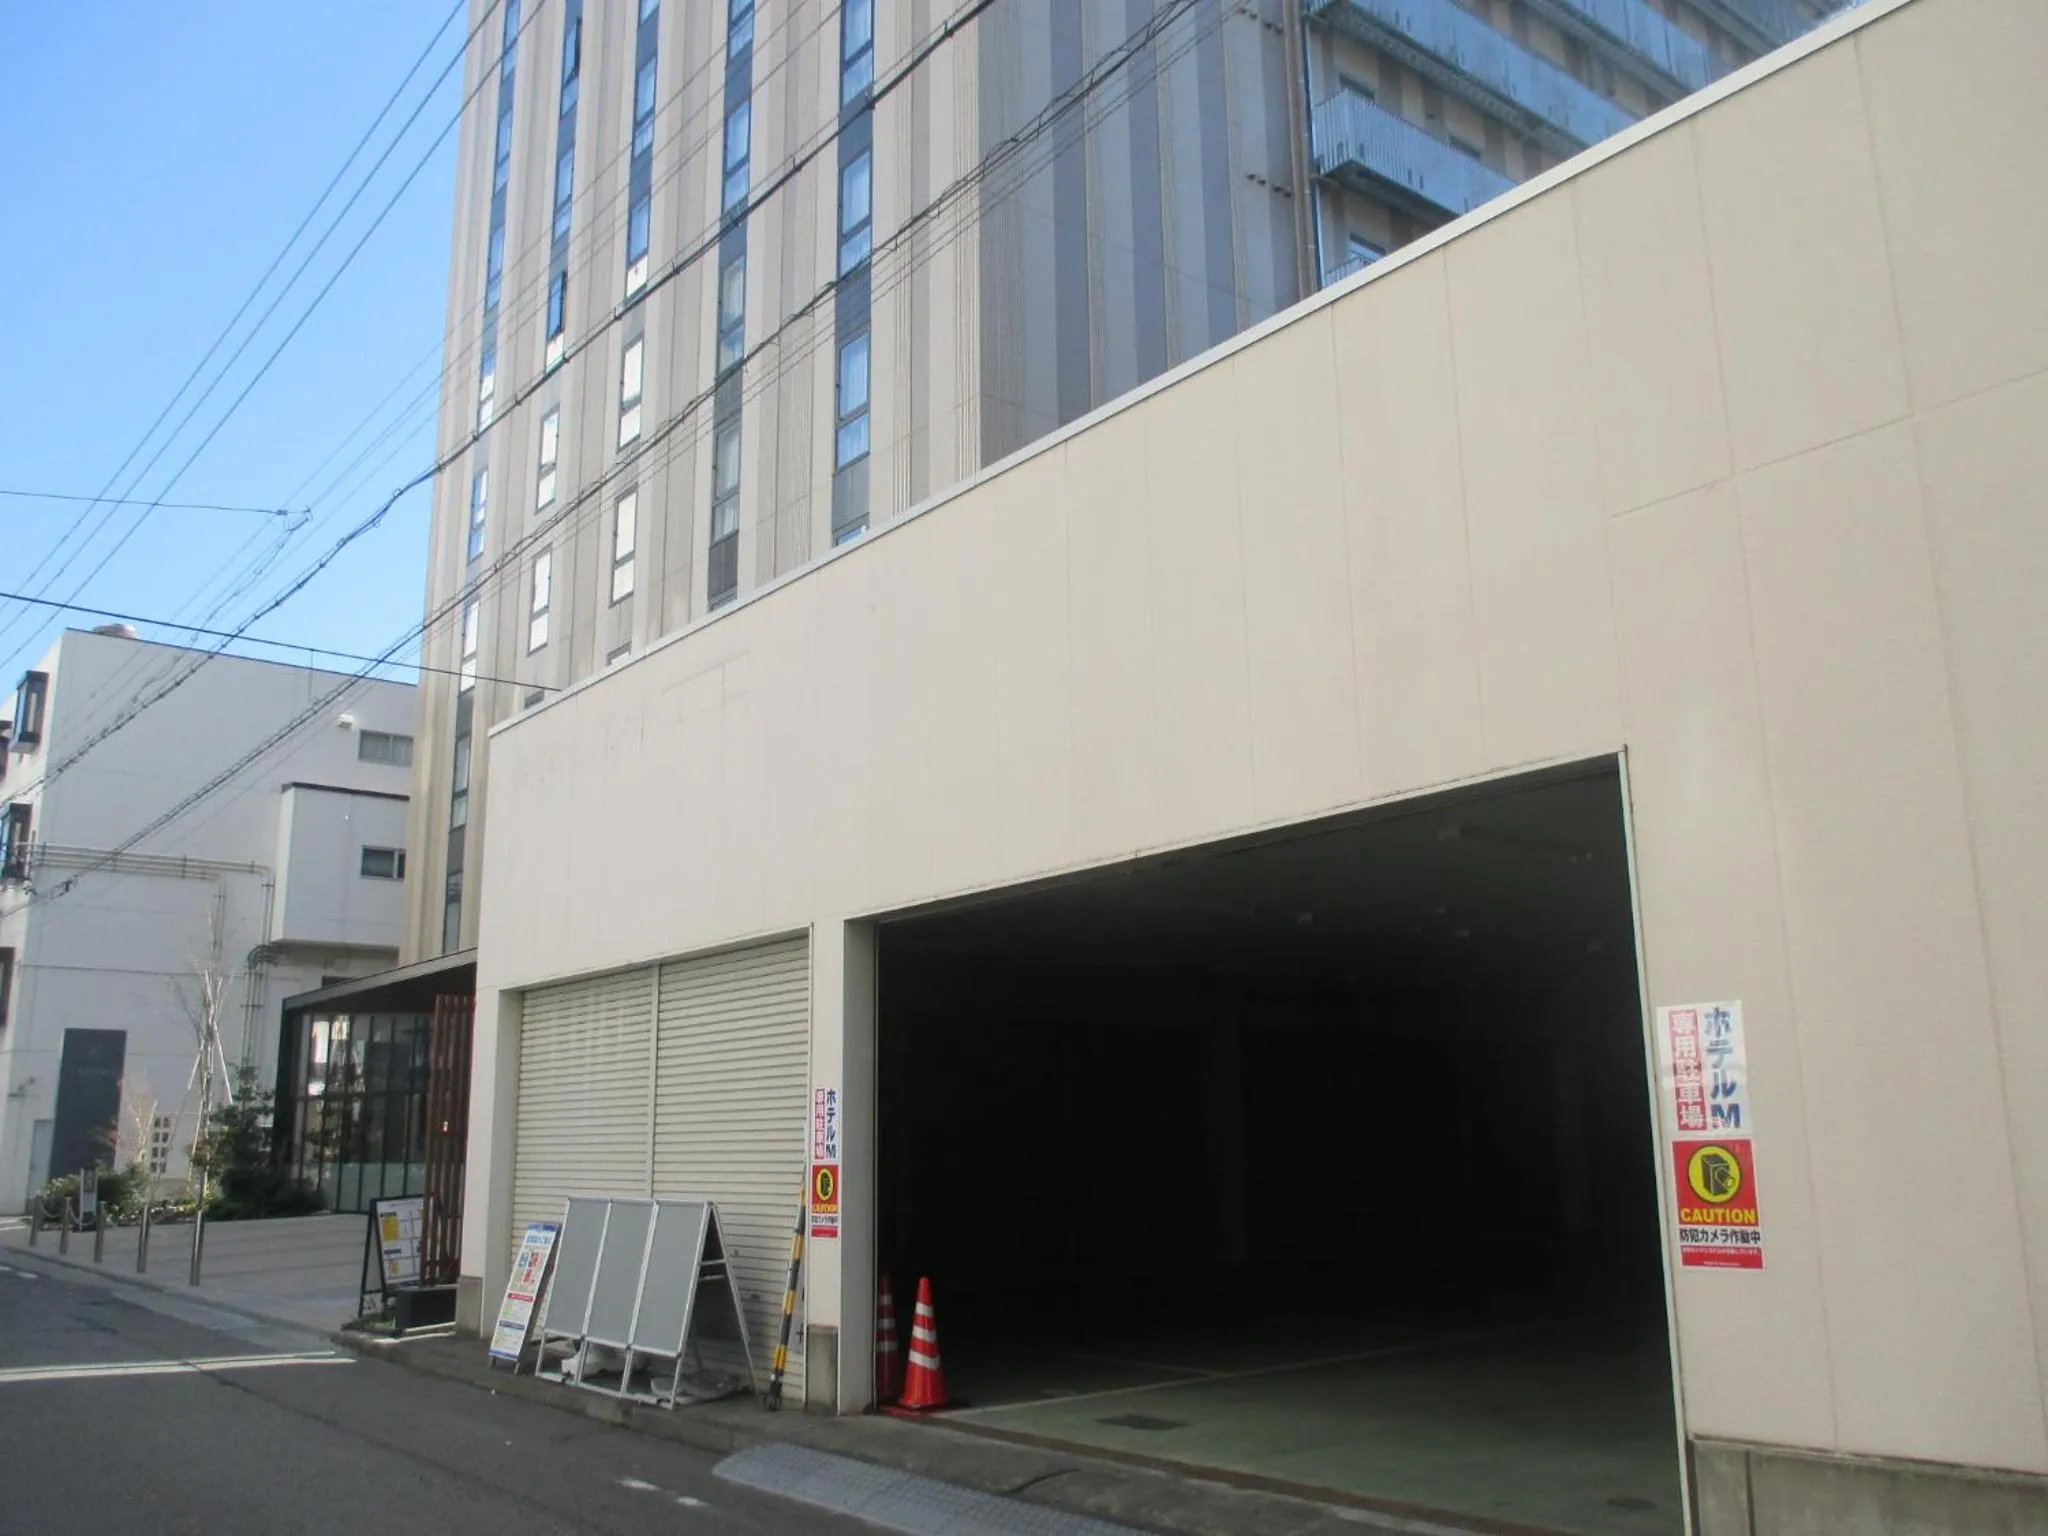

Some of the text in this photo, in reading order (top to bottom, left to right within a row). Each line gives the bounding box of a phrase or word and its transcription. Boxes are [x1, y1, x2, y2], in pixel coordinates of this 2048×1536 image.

[1672, 1013, 1705, 1129] 専用駐車場
[1704, 1007, 1741, 1128] ホテルM
[826, 1088, 836, 1158] ホテルM
[1680, 1228, 1760, 1245] 防犯カメラ作動中
[1681, 1207, 1756, 1225] CAUTION
